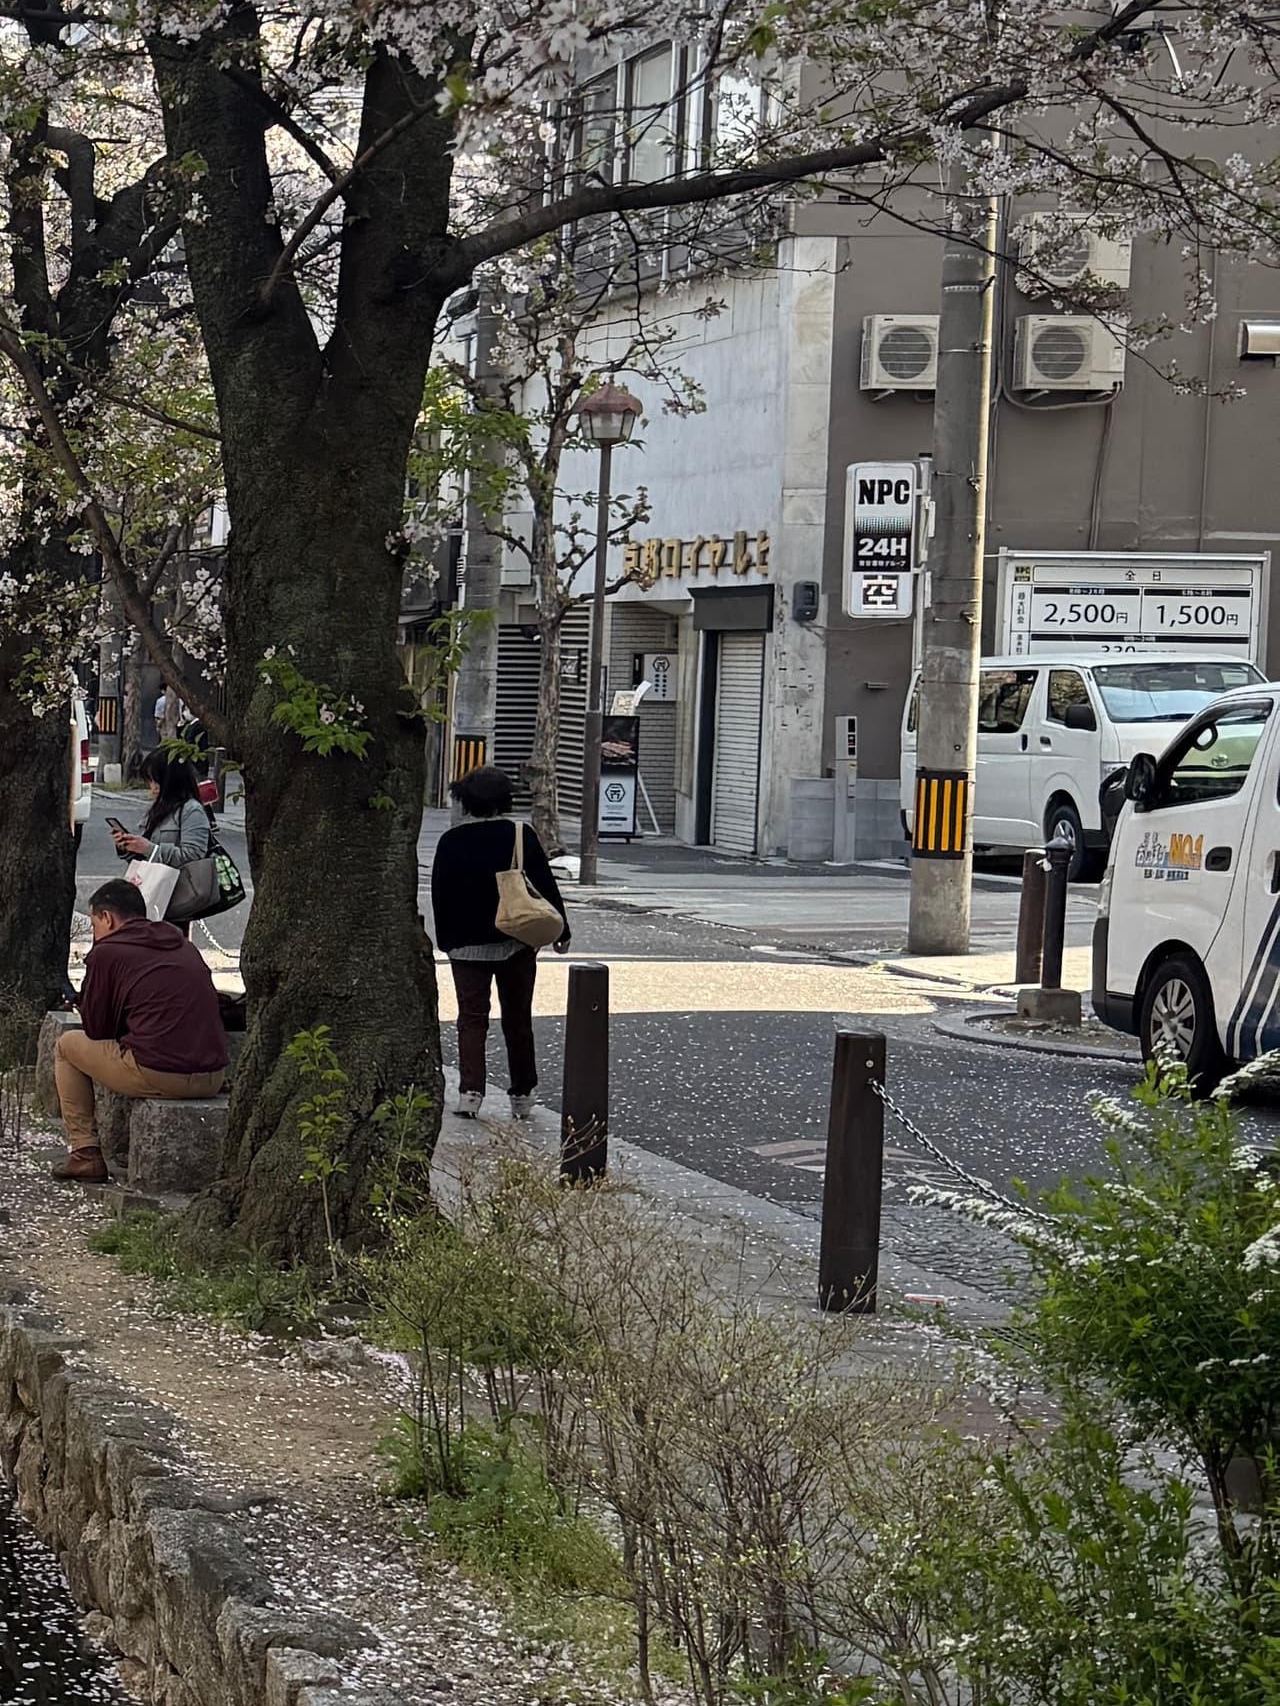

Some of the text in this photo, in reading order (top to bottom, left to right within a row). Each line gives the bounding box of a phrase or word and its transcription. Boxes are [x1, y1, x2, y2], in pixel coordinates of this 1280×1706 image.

[858, 479, 910, 505] NPC
[858, 537, 908, 556] 24H
[861, 574, 899, 610] 空
[1043, 603, 1129, 626] 2,500円
[1156, 604, 1239, 627] 1,500円
